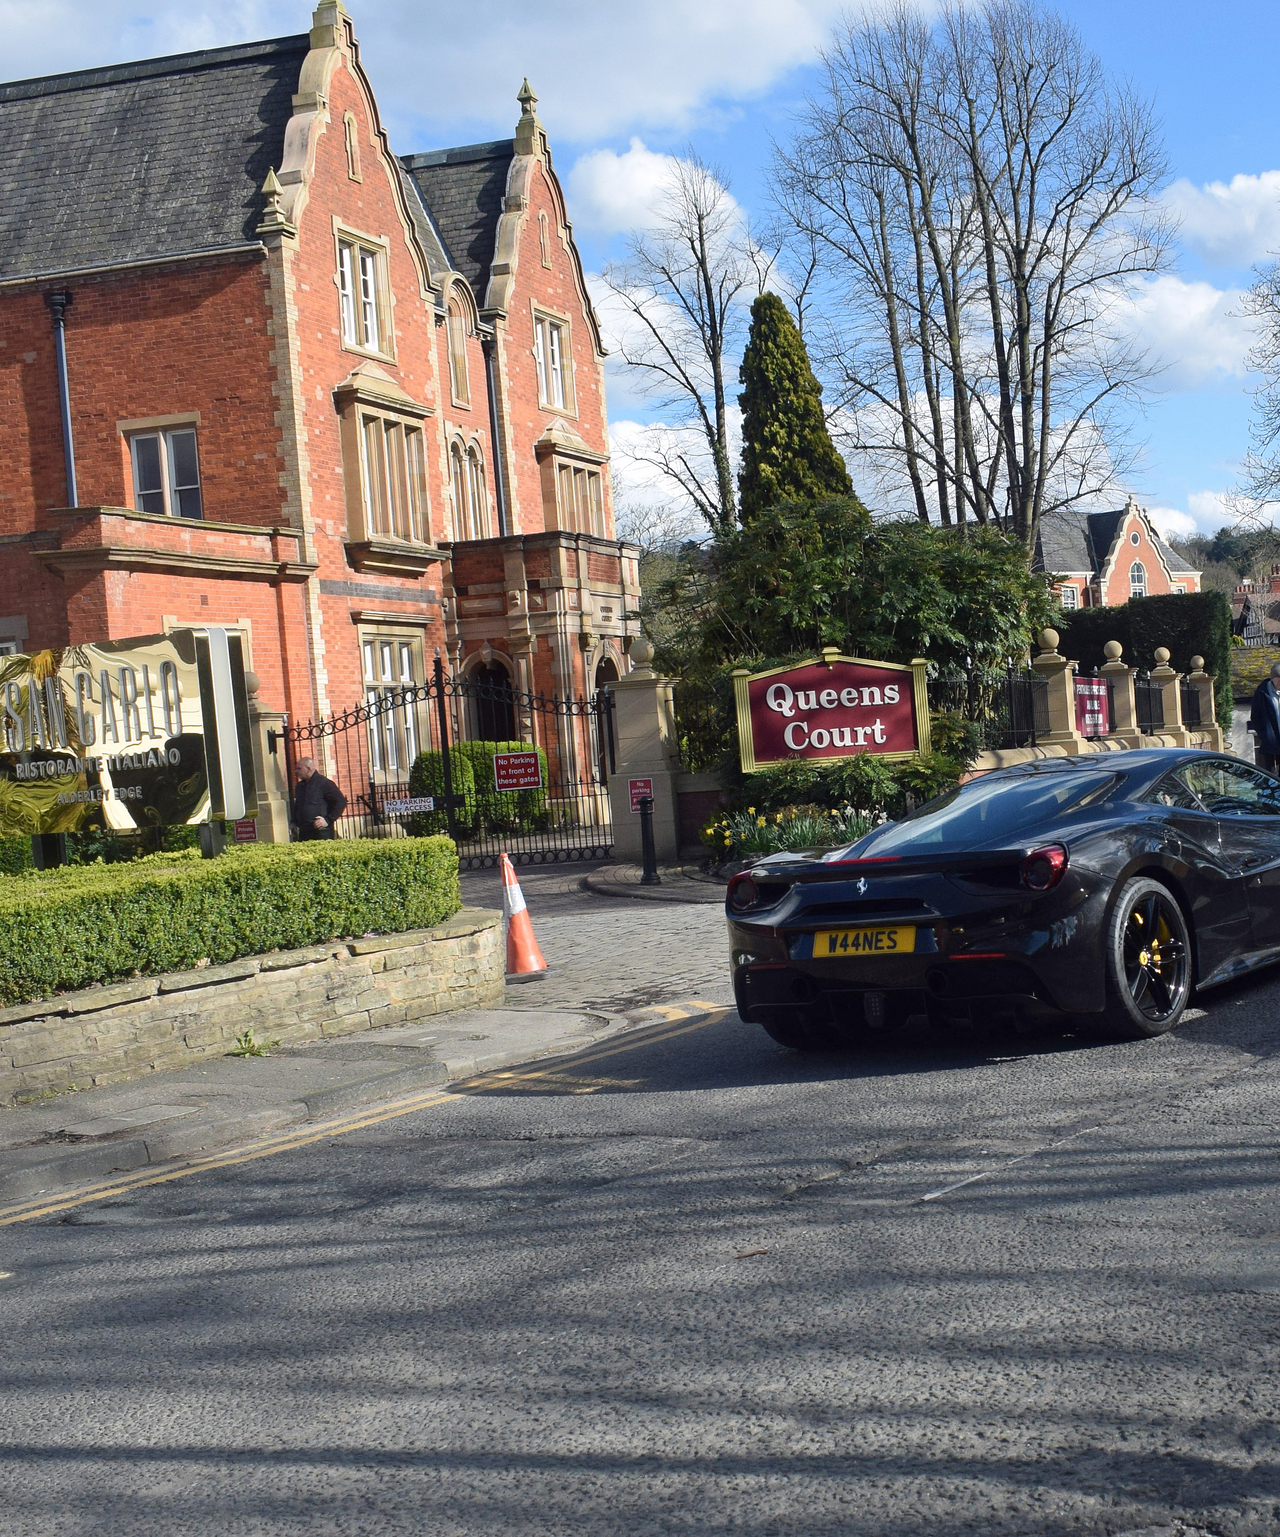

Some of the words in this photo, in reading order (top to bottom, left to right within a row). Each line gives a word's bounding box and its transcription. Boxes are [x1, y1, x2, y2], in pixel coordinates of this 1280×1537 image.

[4, 676, 69, 753] SAN
[75, 660, 183, 747] CARLO
[766, 683, 900, 717] Queens
[784, 718, 887, 750] Court
[16, 755, 105, 779] RISTORANTE
[108, 748, 181, 771] ITALIANO
[510, 756, 535, 764] Parking
[519, 776, 539, 784] gates
[57, 789, 110, 805] ALDERLEY
[114, 785, 143, 800] EDGE
[400, 798, 432, 806] PARKING
[405, 804, 432, 812] ACCESS
[828, 930, 898, 953] W44NES
